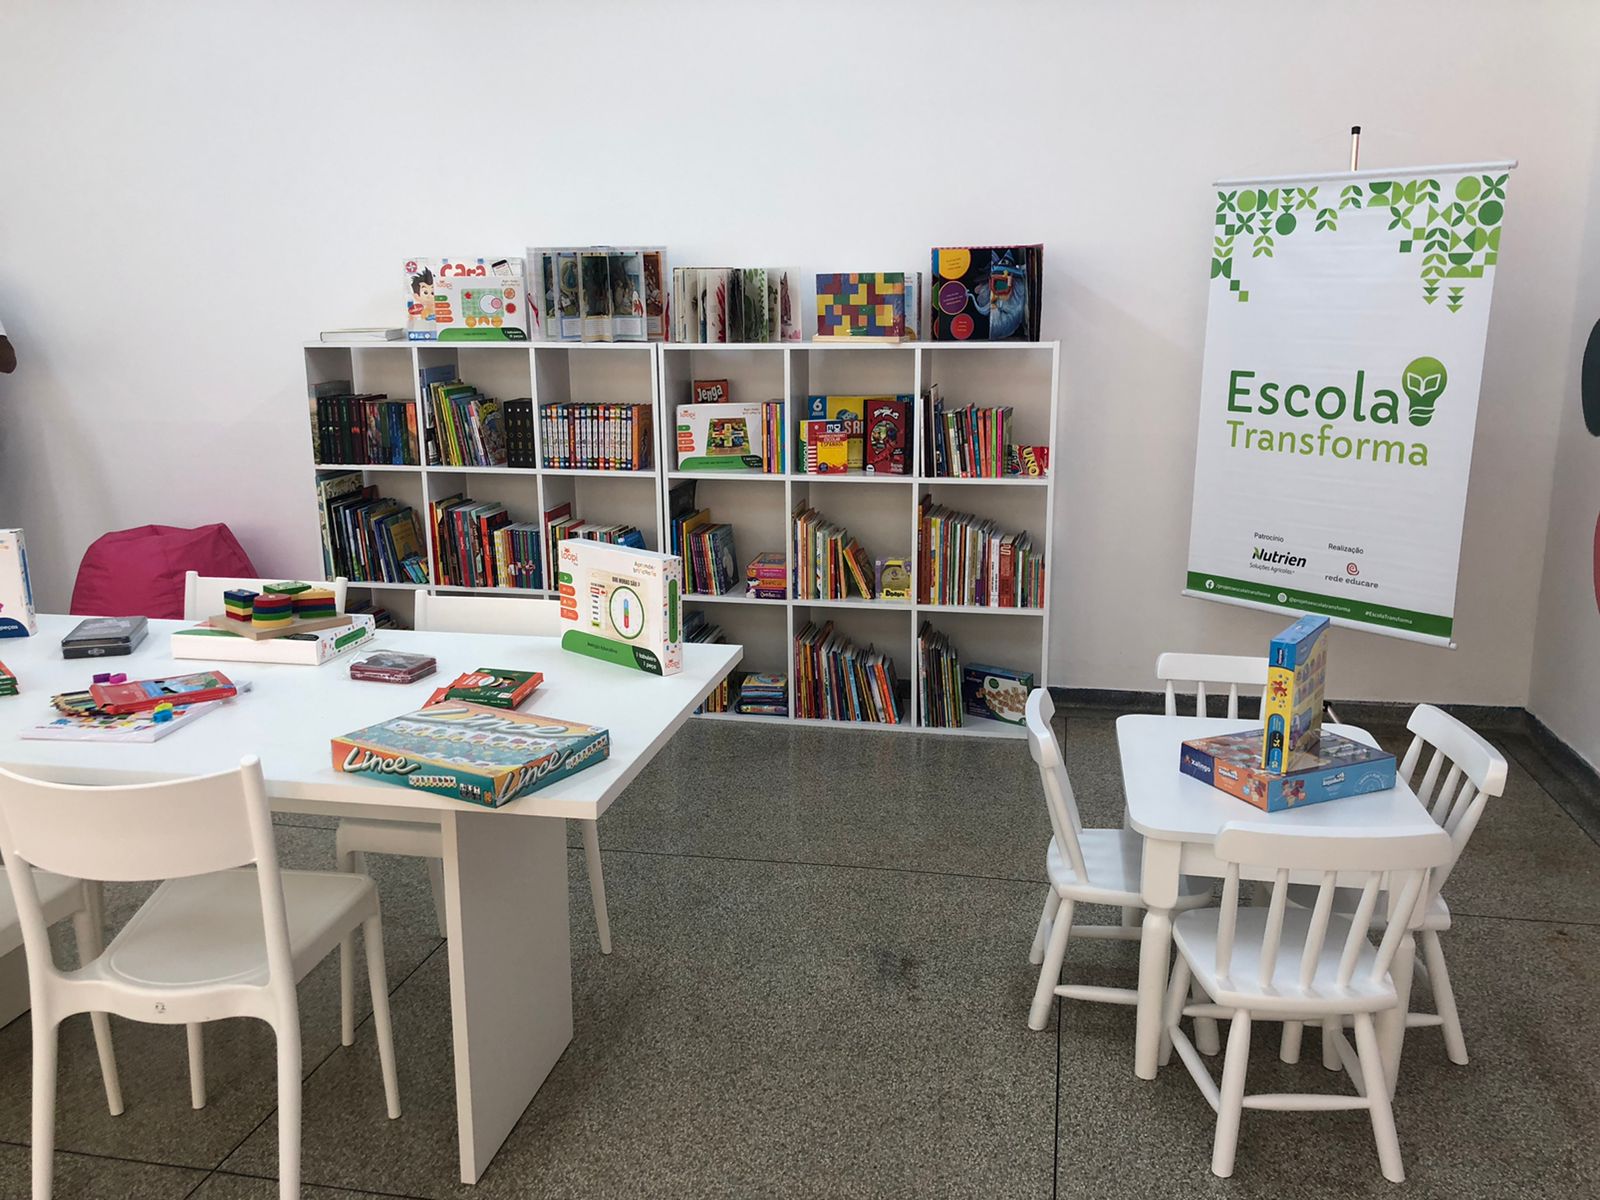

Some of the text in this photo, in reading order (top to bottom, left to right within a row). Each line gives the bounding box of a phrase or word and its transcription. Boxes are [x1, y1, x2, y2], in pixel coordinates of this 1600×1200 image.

[697, 384, 723, 402] Jenga
[813, 398, 822, 411] 6
[1226, 369, 1399, 425] Escola
[1226, 420, 1429, 467] Transforma
[1022, 446, 1039, 476] UNO
[1252, 547, 1307, 568] Nutrien
[1328, 543, 1364, 555] Realização
[1324, 574, 1379, 589] rede educare
[1364, 610, 1413, 625] #EscolaTransforma
[399, 706, 588, 739] Lince
[341, 746, 421, 775] Lince
[498, 748, 573, 802] Lince
